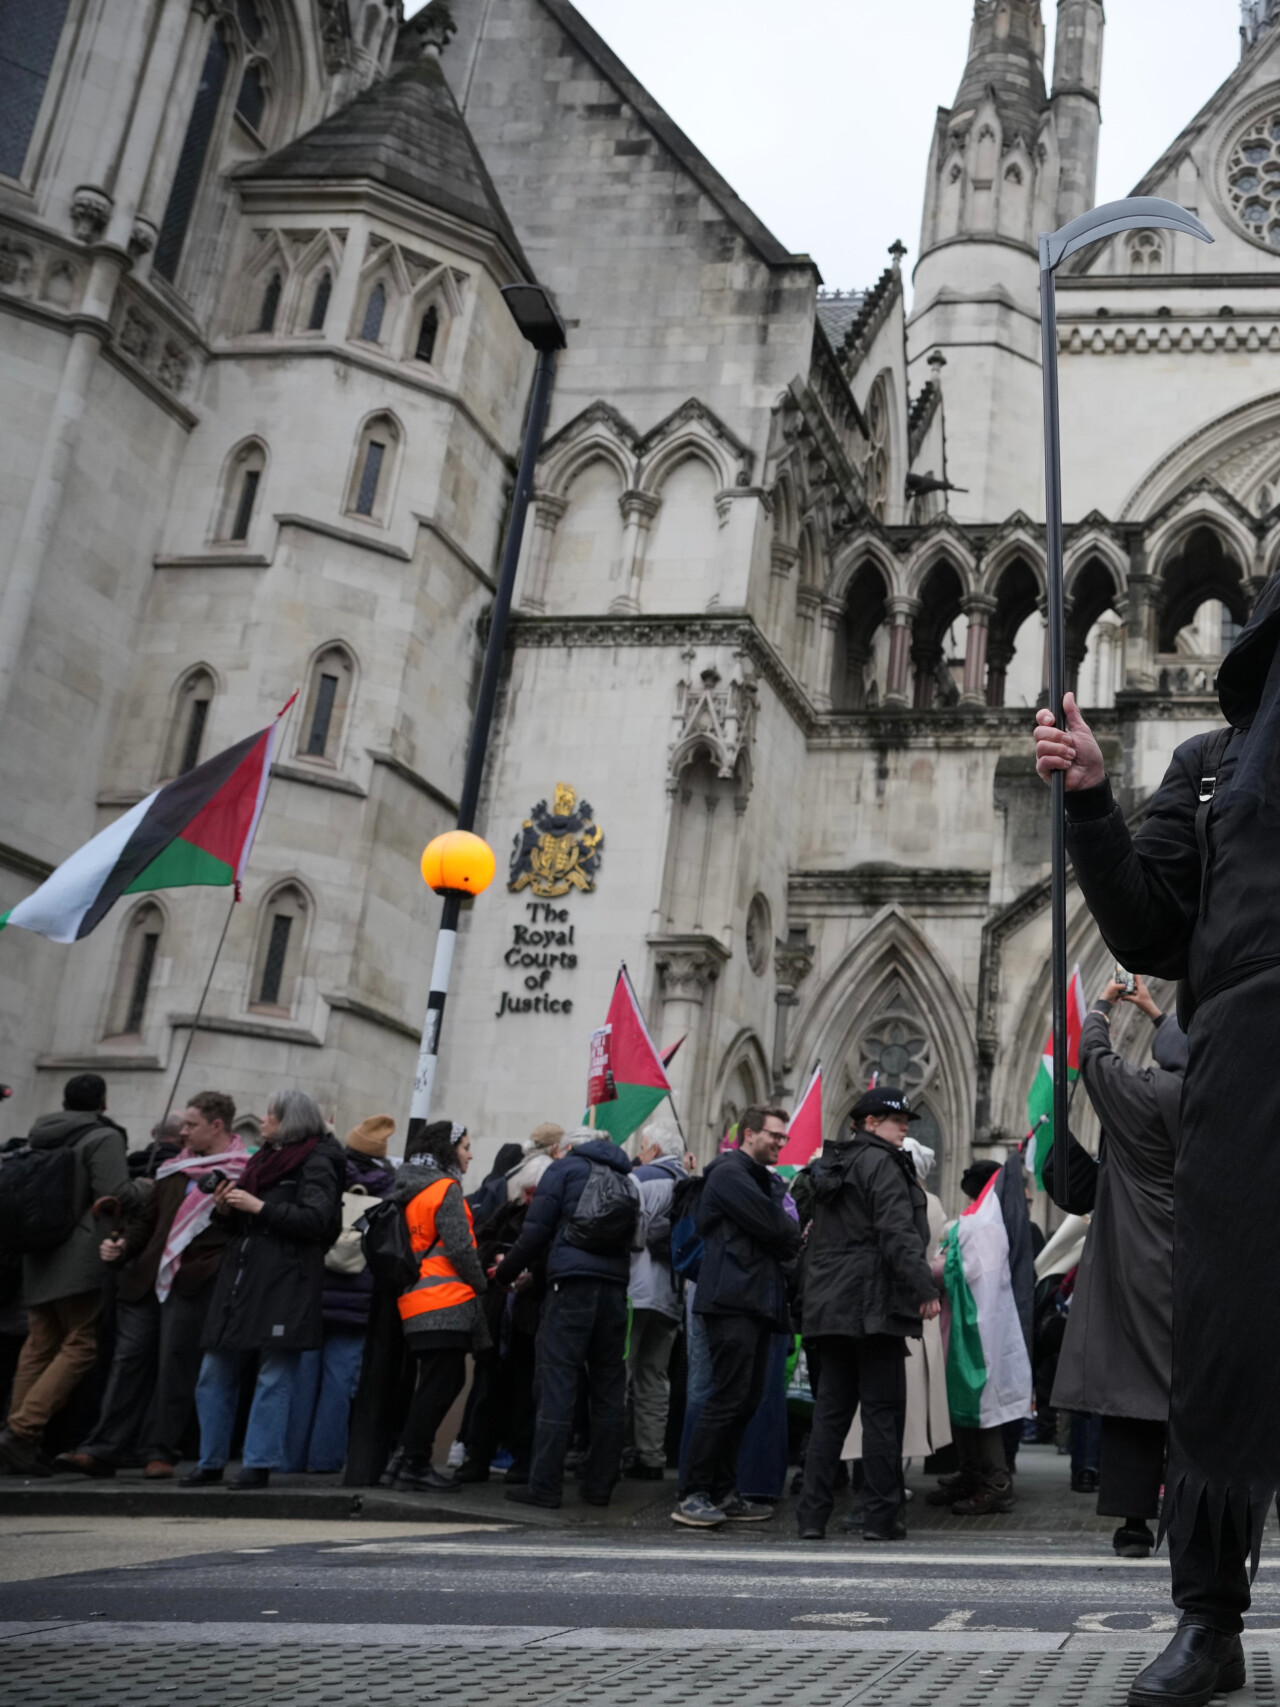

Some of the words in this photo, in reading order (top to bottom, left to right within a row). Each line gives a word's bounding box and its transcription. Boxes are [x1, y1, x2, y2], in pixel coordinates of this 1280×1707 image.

[526, 902, 569, 924] The
[513, 925, 575, 948] Royal
[504, 948, 578, 970] Courts
[524, 969, 551, 991] of
[495, 991, 573, 1019] Justice
